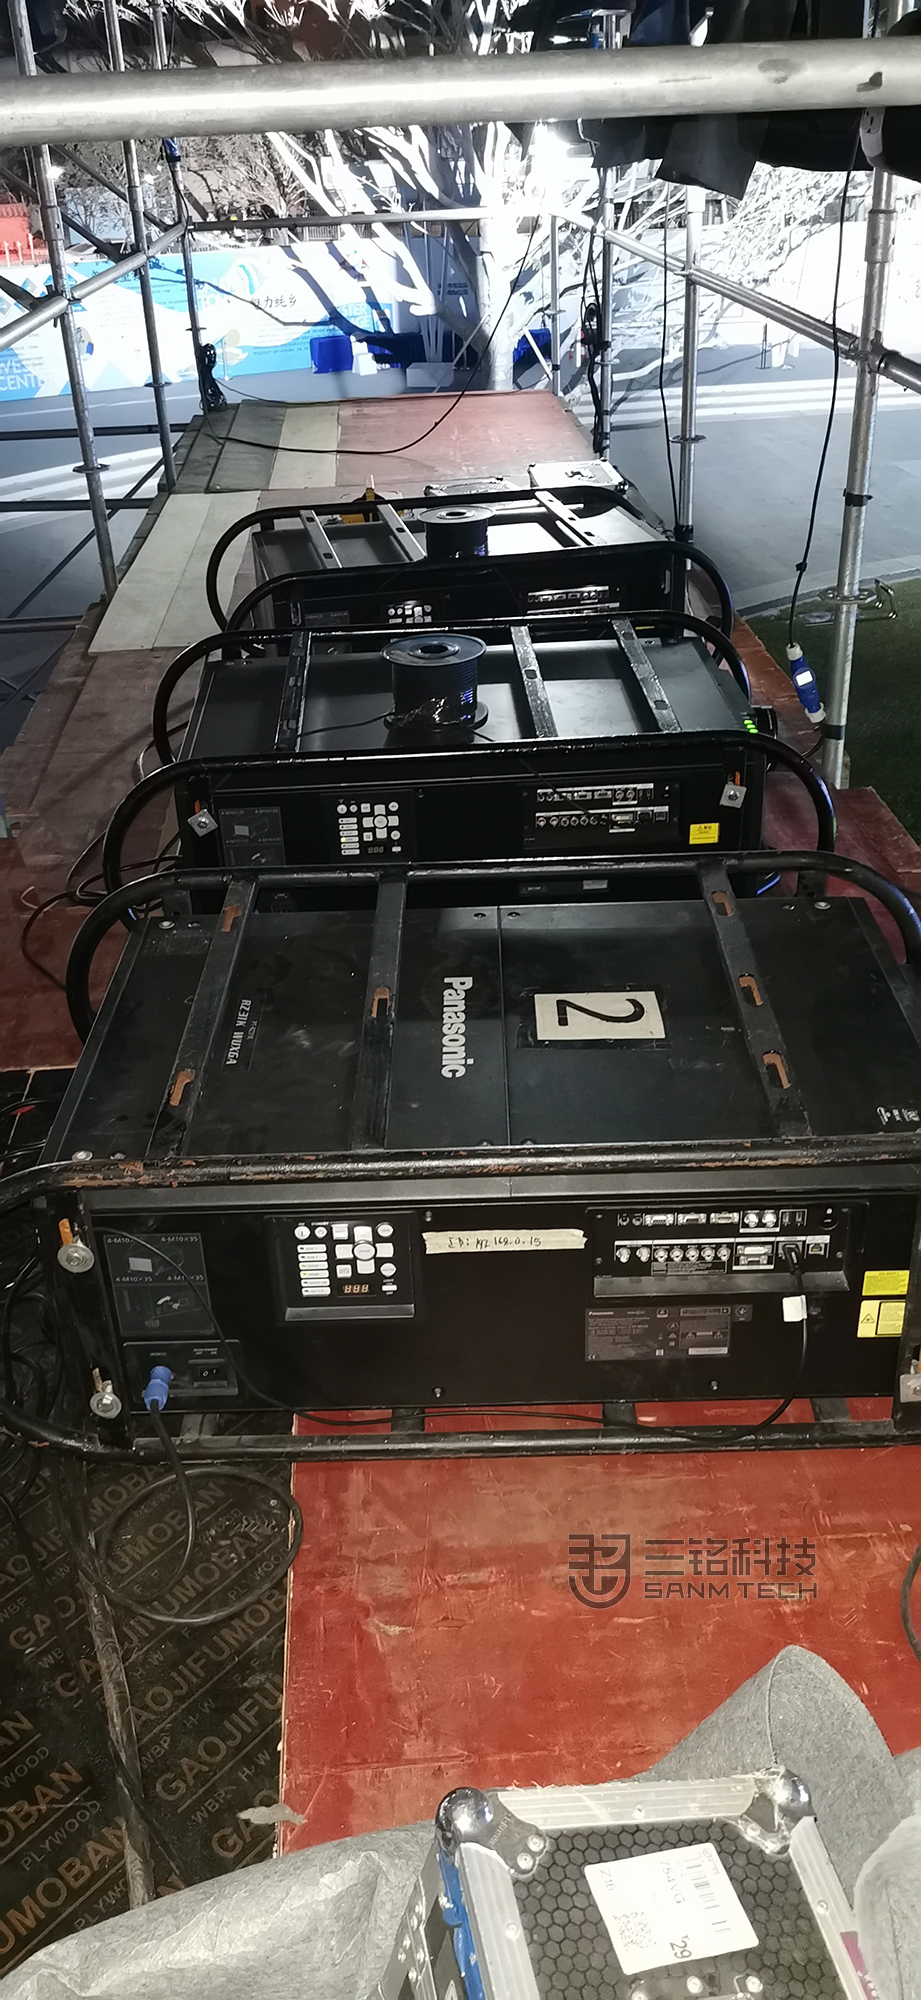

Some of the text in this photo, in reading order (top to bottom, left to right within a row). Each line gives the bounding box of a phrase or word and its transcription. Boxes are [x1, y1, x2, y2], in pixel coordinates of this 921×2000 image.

[441, 976, 475, 1079] Panasonic
[556, 998, 645, 1027] 2
[20, 1800, 101, 1872] PLYWOOD
